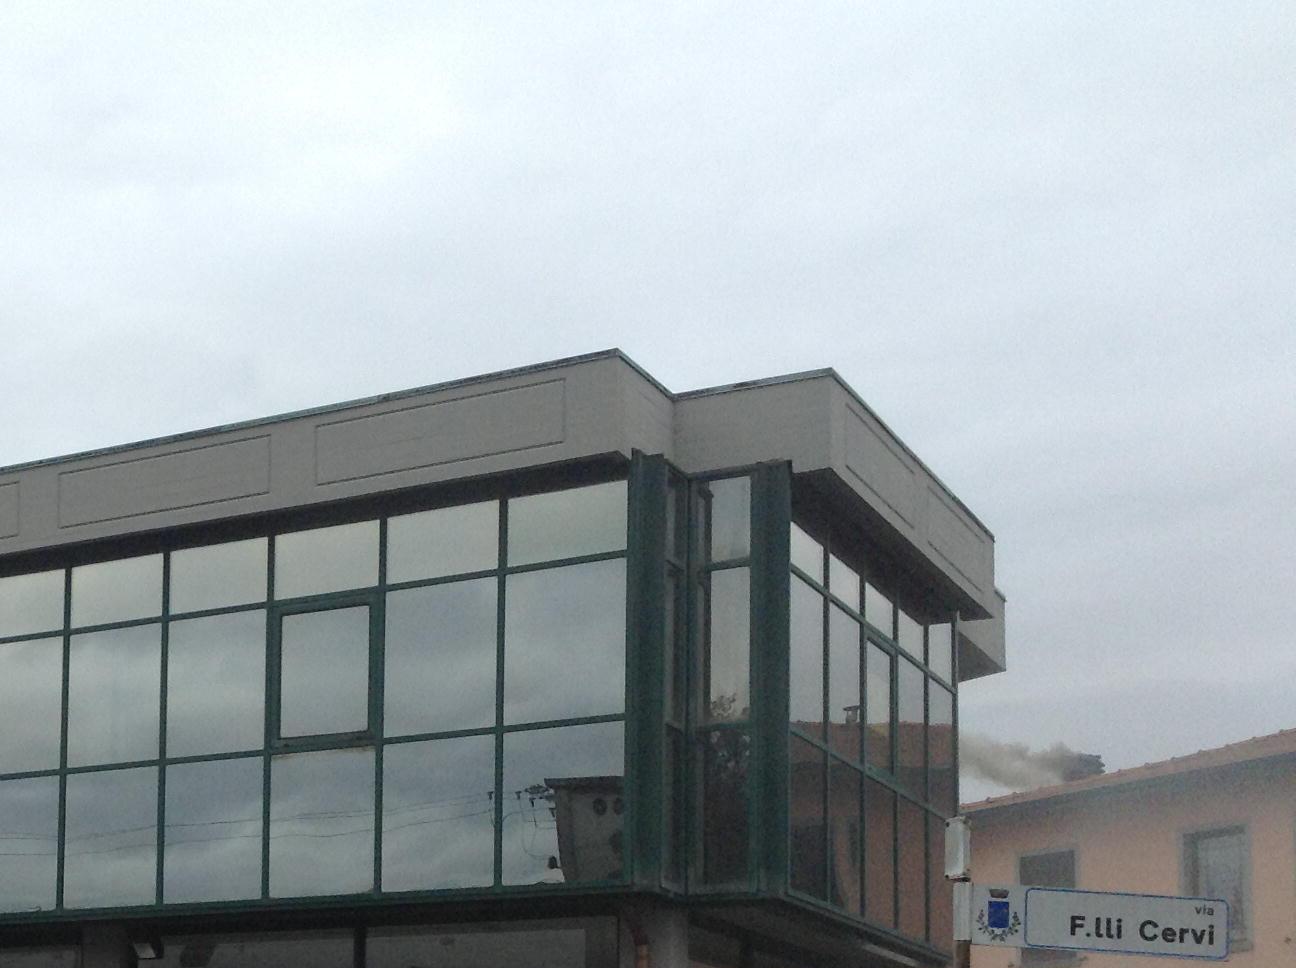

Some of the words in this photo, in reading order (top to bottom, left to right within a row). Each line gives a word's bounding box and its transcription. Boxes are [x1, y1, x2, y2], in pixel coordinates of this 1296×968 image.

[1194, 904, 1215, 916] via
[1069, 915, 1123, 939] F.lli
[1138, 919, 1215, 945] Cervi
